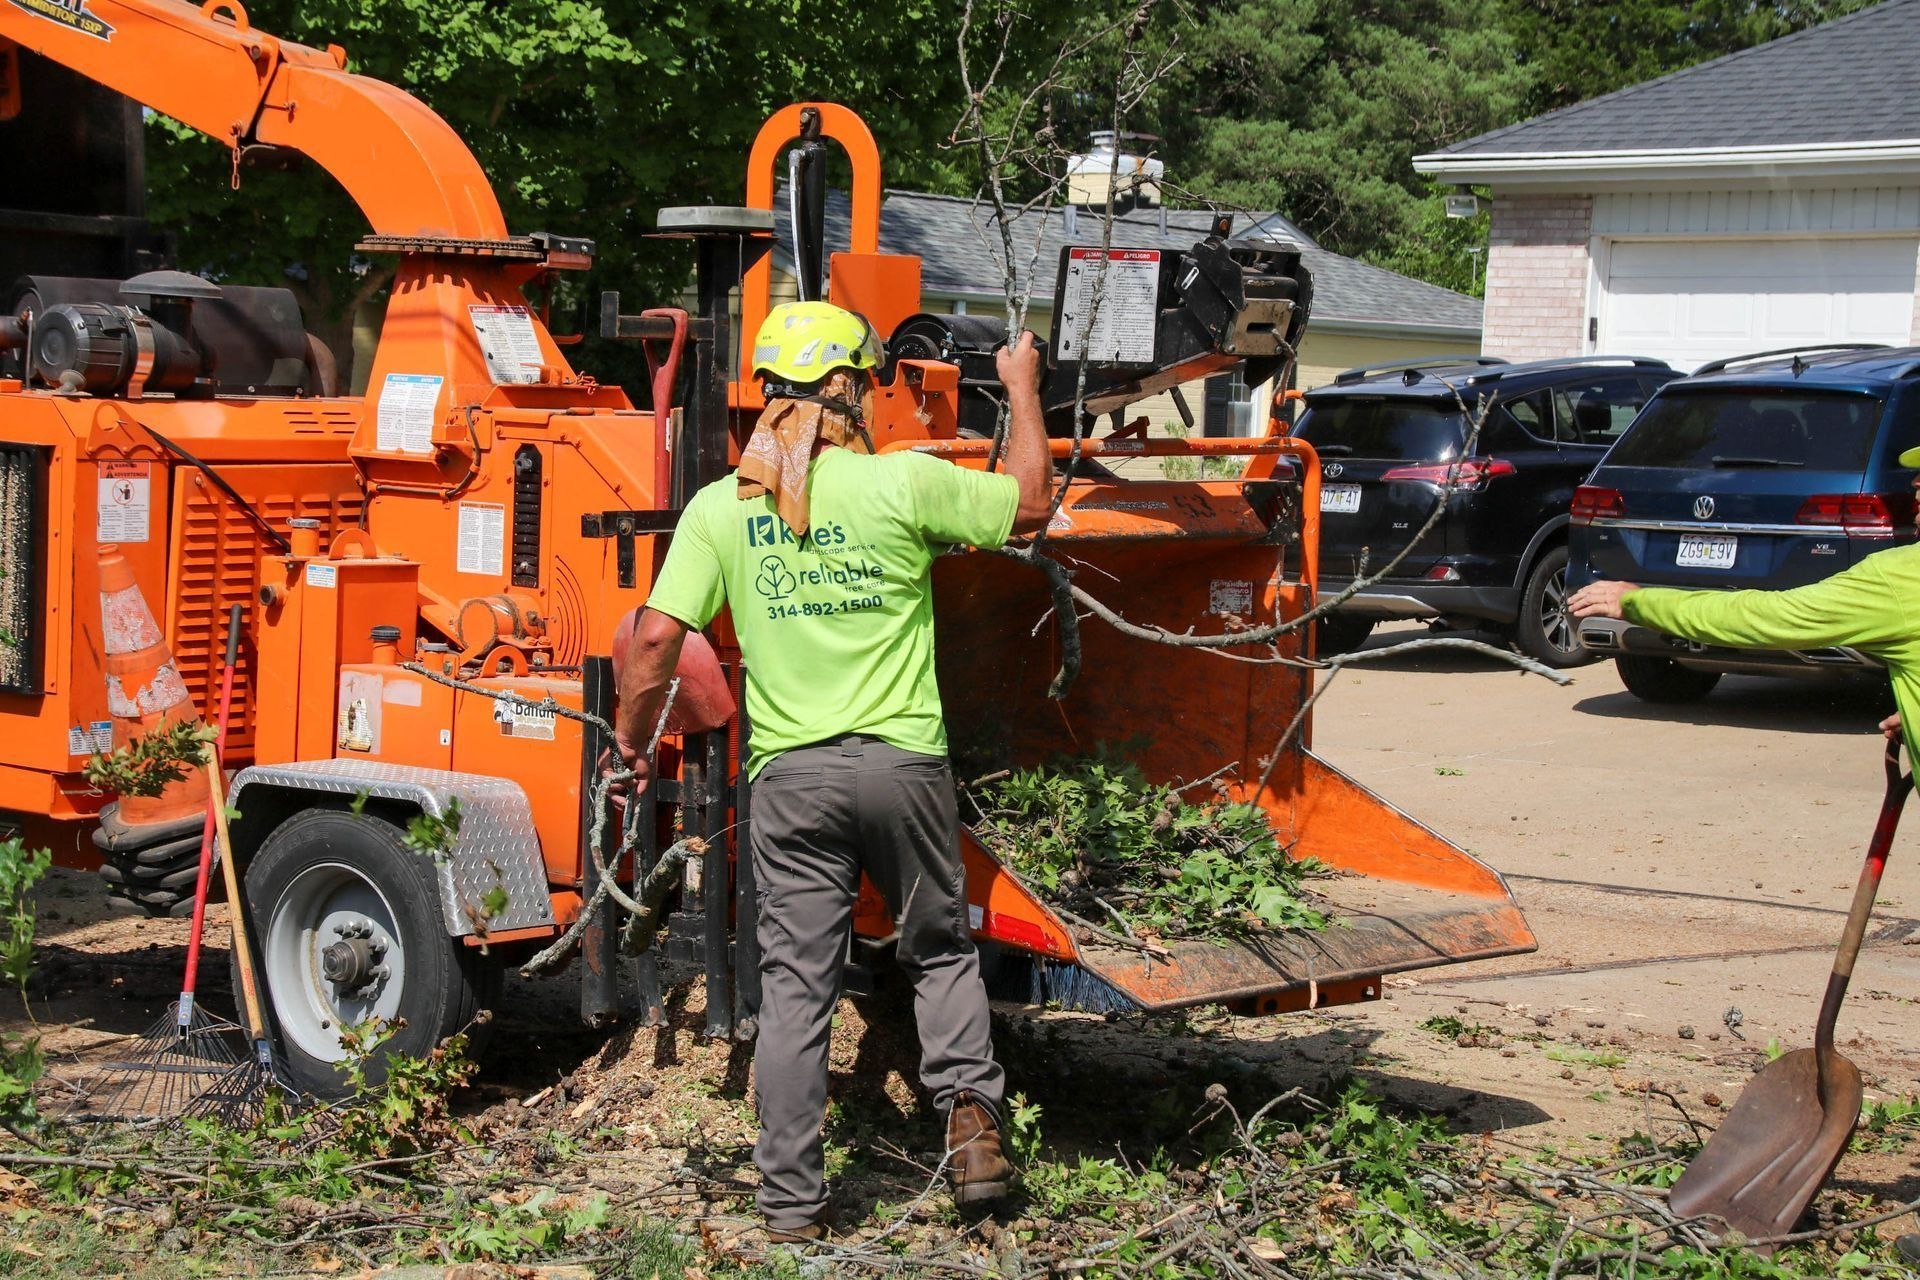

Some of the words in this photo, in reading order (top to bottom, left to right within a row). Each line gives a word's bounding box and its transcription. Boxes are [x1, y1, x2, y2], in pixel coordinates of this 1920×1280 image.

[80, 18, 102, 33] 15XP
[1320, 490, 1336, 504] D7
[780, 519, 846, 552] kye's
[847, 543, 876, 552] service
[1680, 541, 1704, 558] ZG9
[1709, 543, 1734, 559] E9V
[799, 559, 883, 585] reliable
[844, 585, 864, 593] tree
[866, 580, 885, 589] care
[767, 595, 883, 620] 314-892-1500
